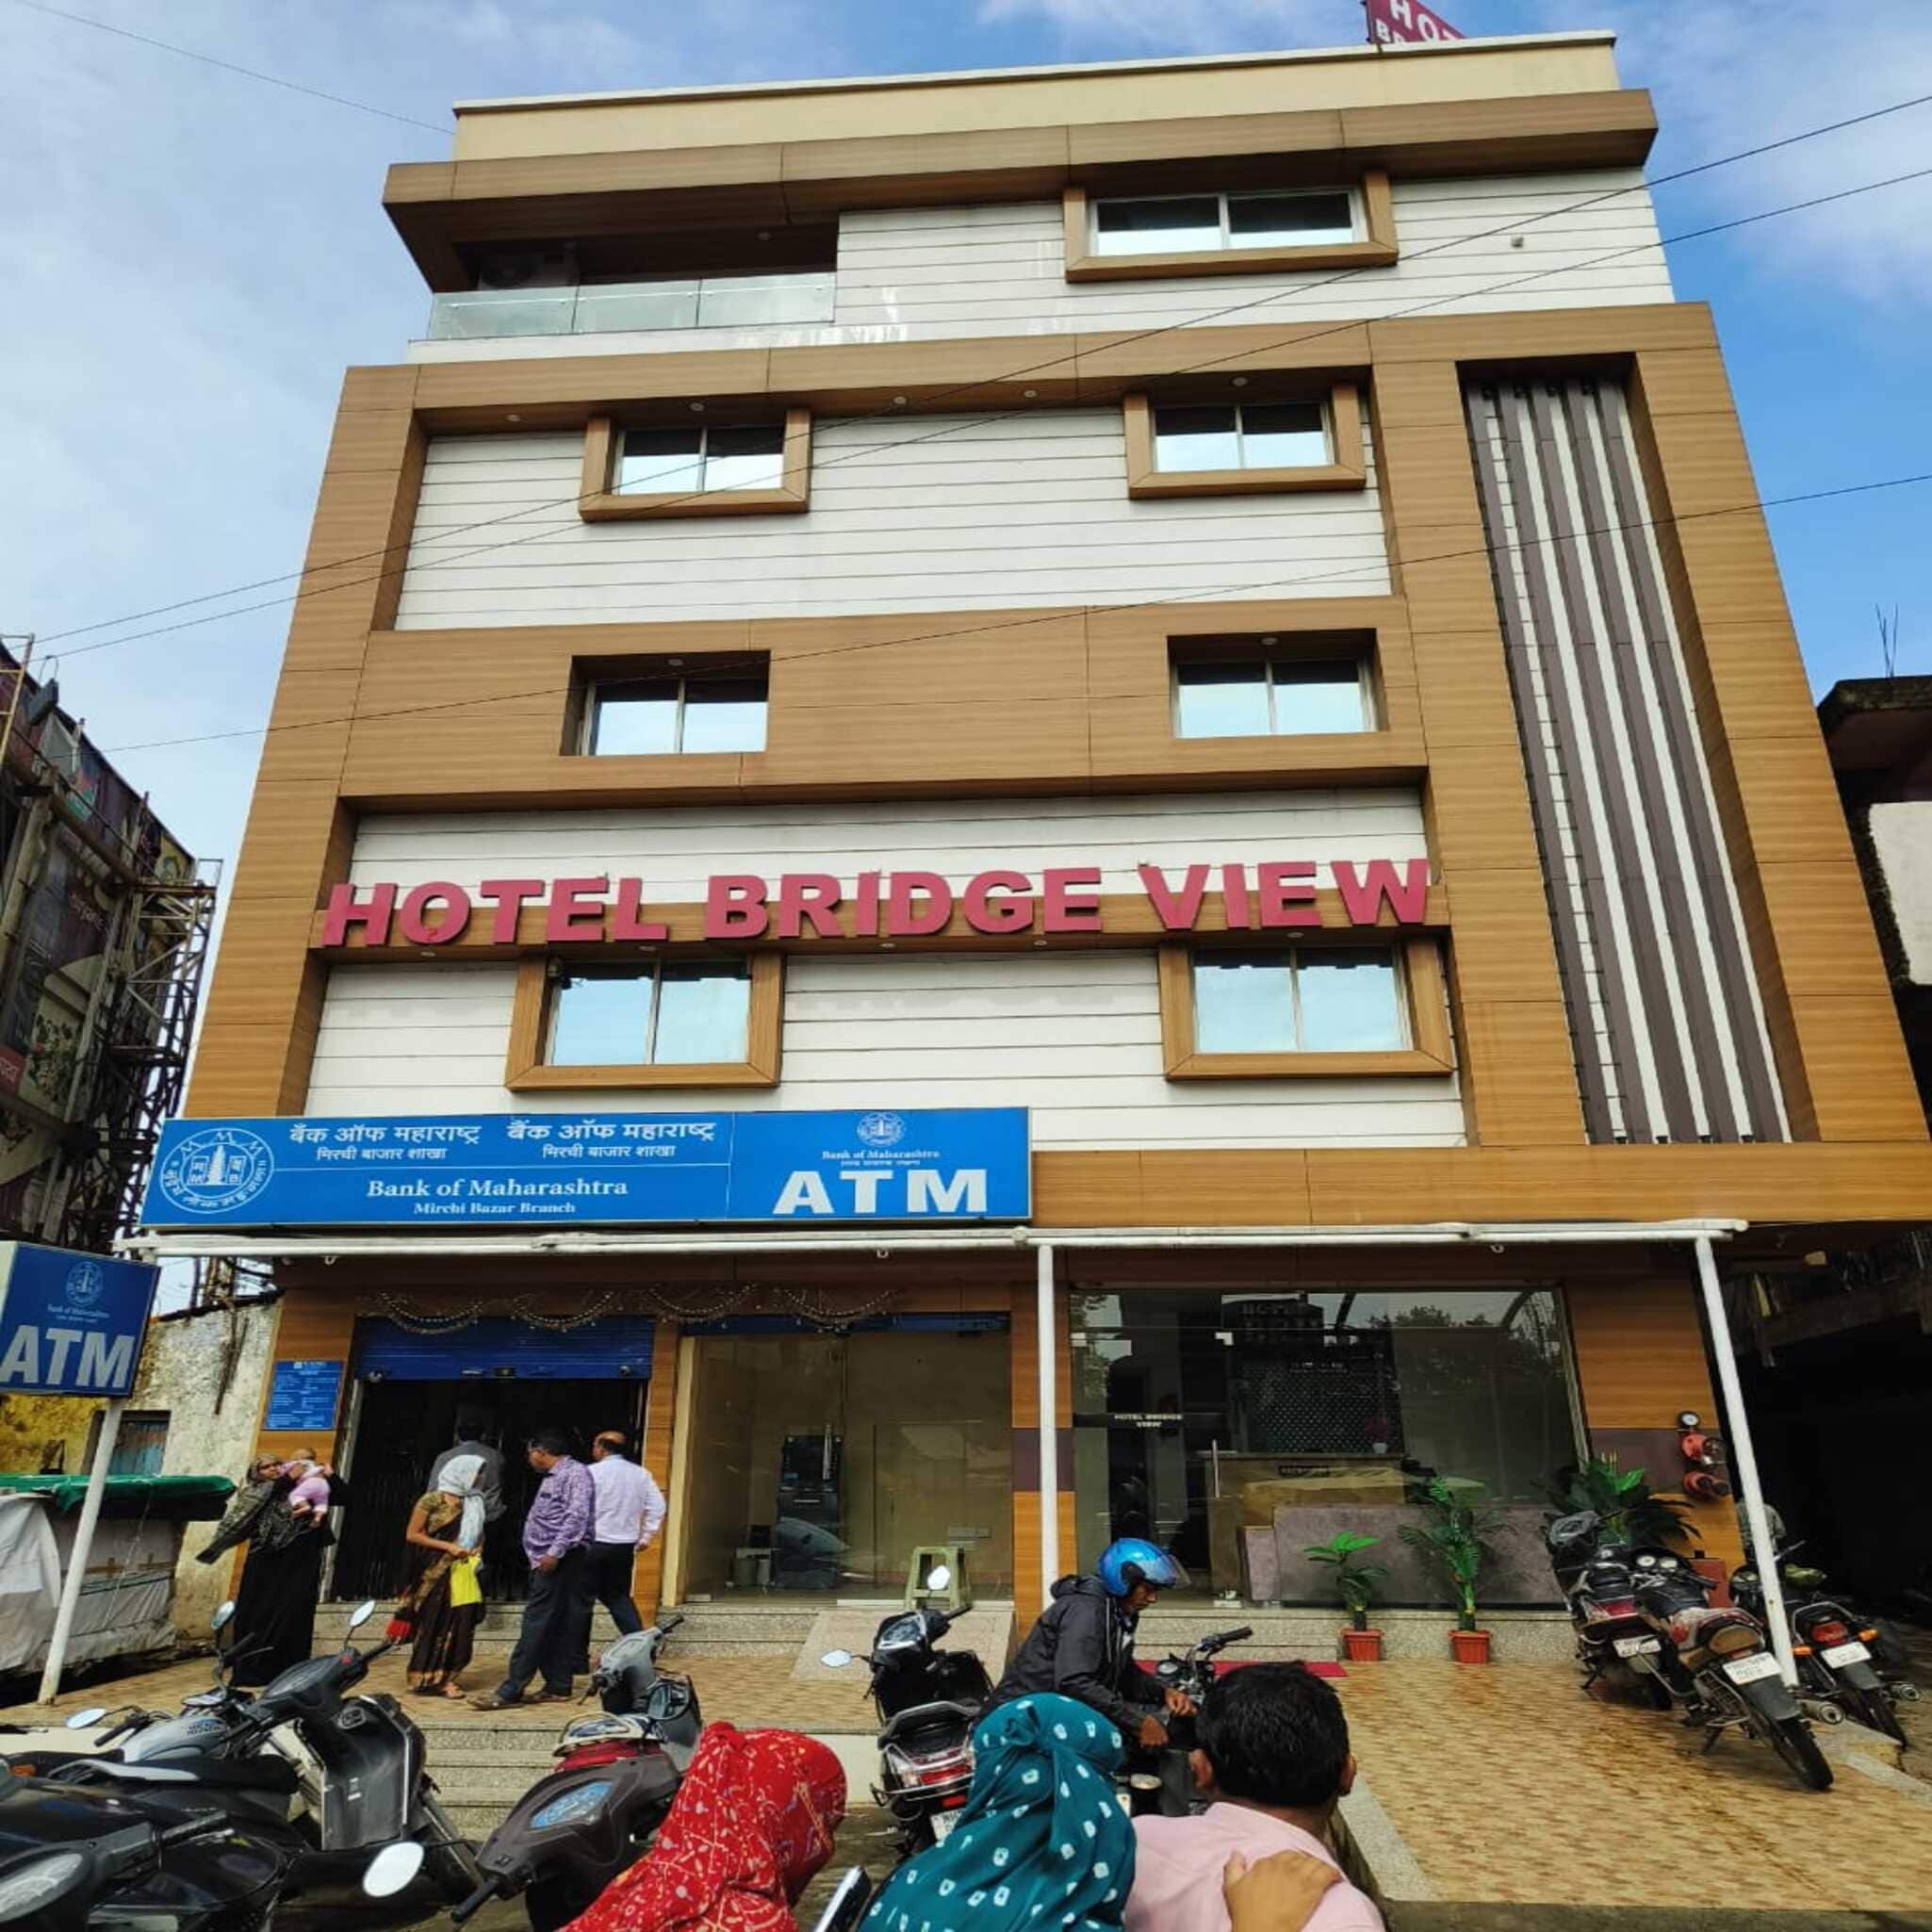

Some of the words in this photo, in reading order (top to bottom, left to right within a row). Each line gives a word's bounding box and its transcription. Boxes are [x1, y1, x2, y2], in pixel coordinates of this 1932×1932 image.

[321, 877, 668, 946] HOTEL
[704, 867, 1103, 941] BRIDGE
[1138, 859, 1430, 930] VIEW
[335, 1124, 387, 1142] ऑफ
[393, 1125, 483, 1145] महाराष्ट्र
[506, 1119, 552, 1139] बैंक
[558, 1119, 616, 1138] ऑफ
[622, 1122, 716, 1141] महाराष्ट्र
[361, 1148, 404, 1159] बाजार
[407, 1148, 448, 1159] शाखा
[587, 1145, 631, 1157] बाजार
[635, 1145, 676, 1157] शाखा
[367, 1178, 431, 1197] Bank
[436, 1178, 464, 1197] of
[469, 1178, 628, 1197] Maharashtra
[773, 1169, 988, 1215] ATM
[414, 1203, 466, 1214] Mirchi
[470, 1203, 516, 1214] Bazar
[520, 1203, 576, 1214] Branch
[0, 1325, 136, 1388] ATM
